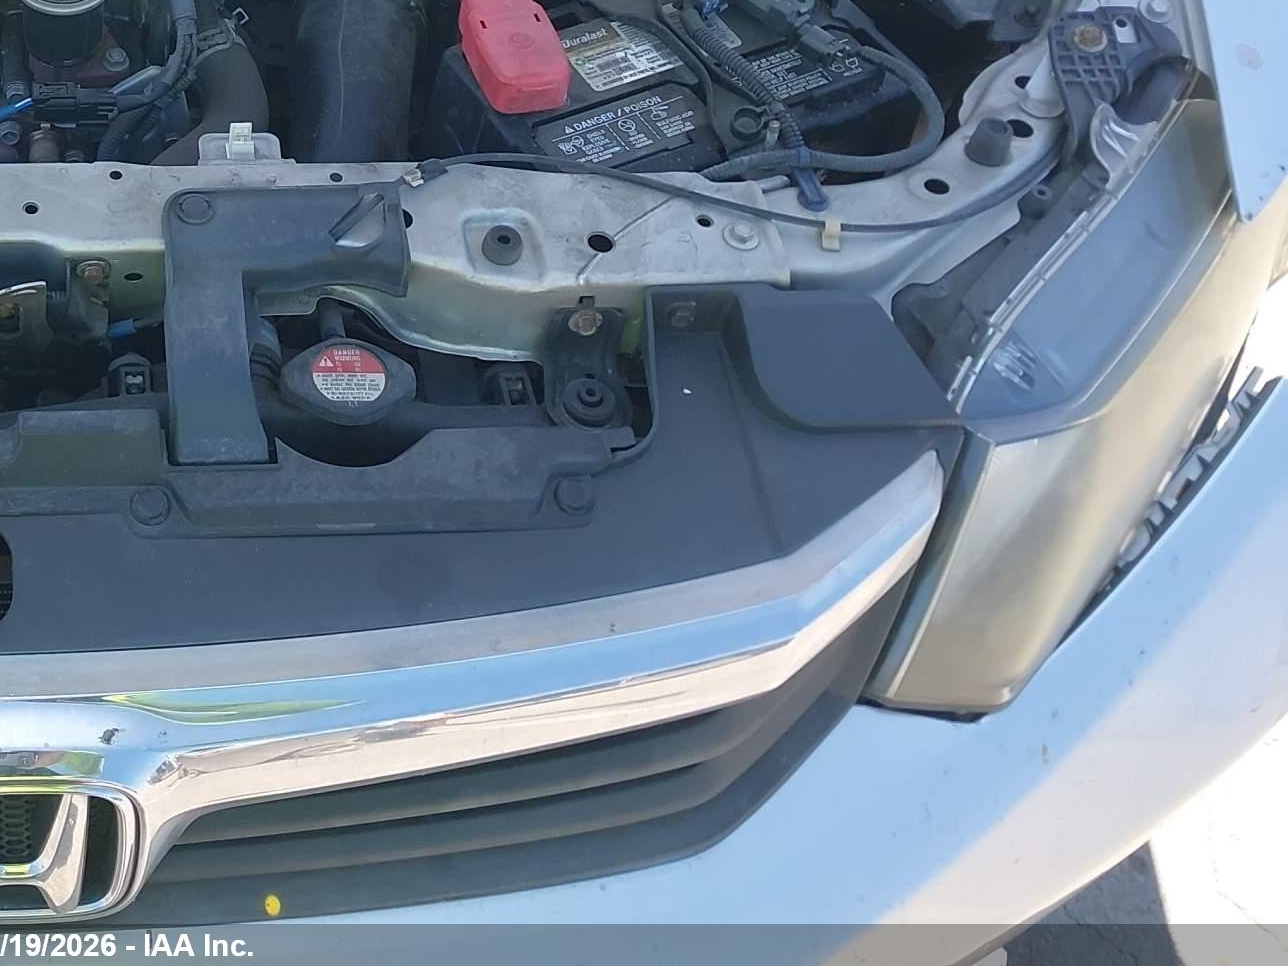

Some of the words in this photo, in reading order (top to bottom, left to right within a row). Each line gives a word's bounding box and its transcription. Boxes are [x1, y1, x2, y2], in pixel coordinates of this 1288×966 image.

[561, 28, 609, 49] Duralast
[573, 112, 616, 131] DANGER
[625, 96, 662, 114] POISON
